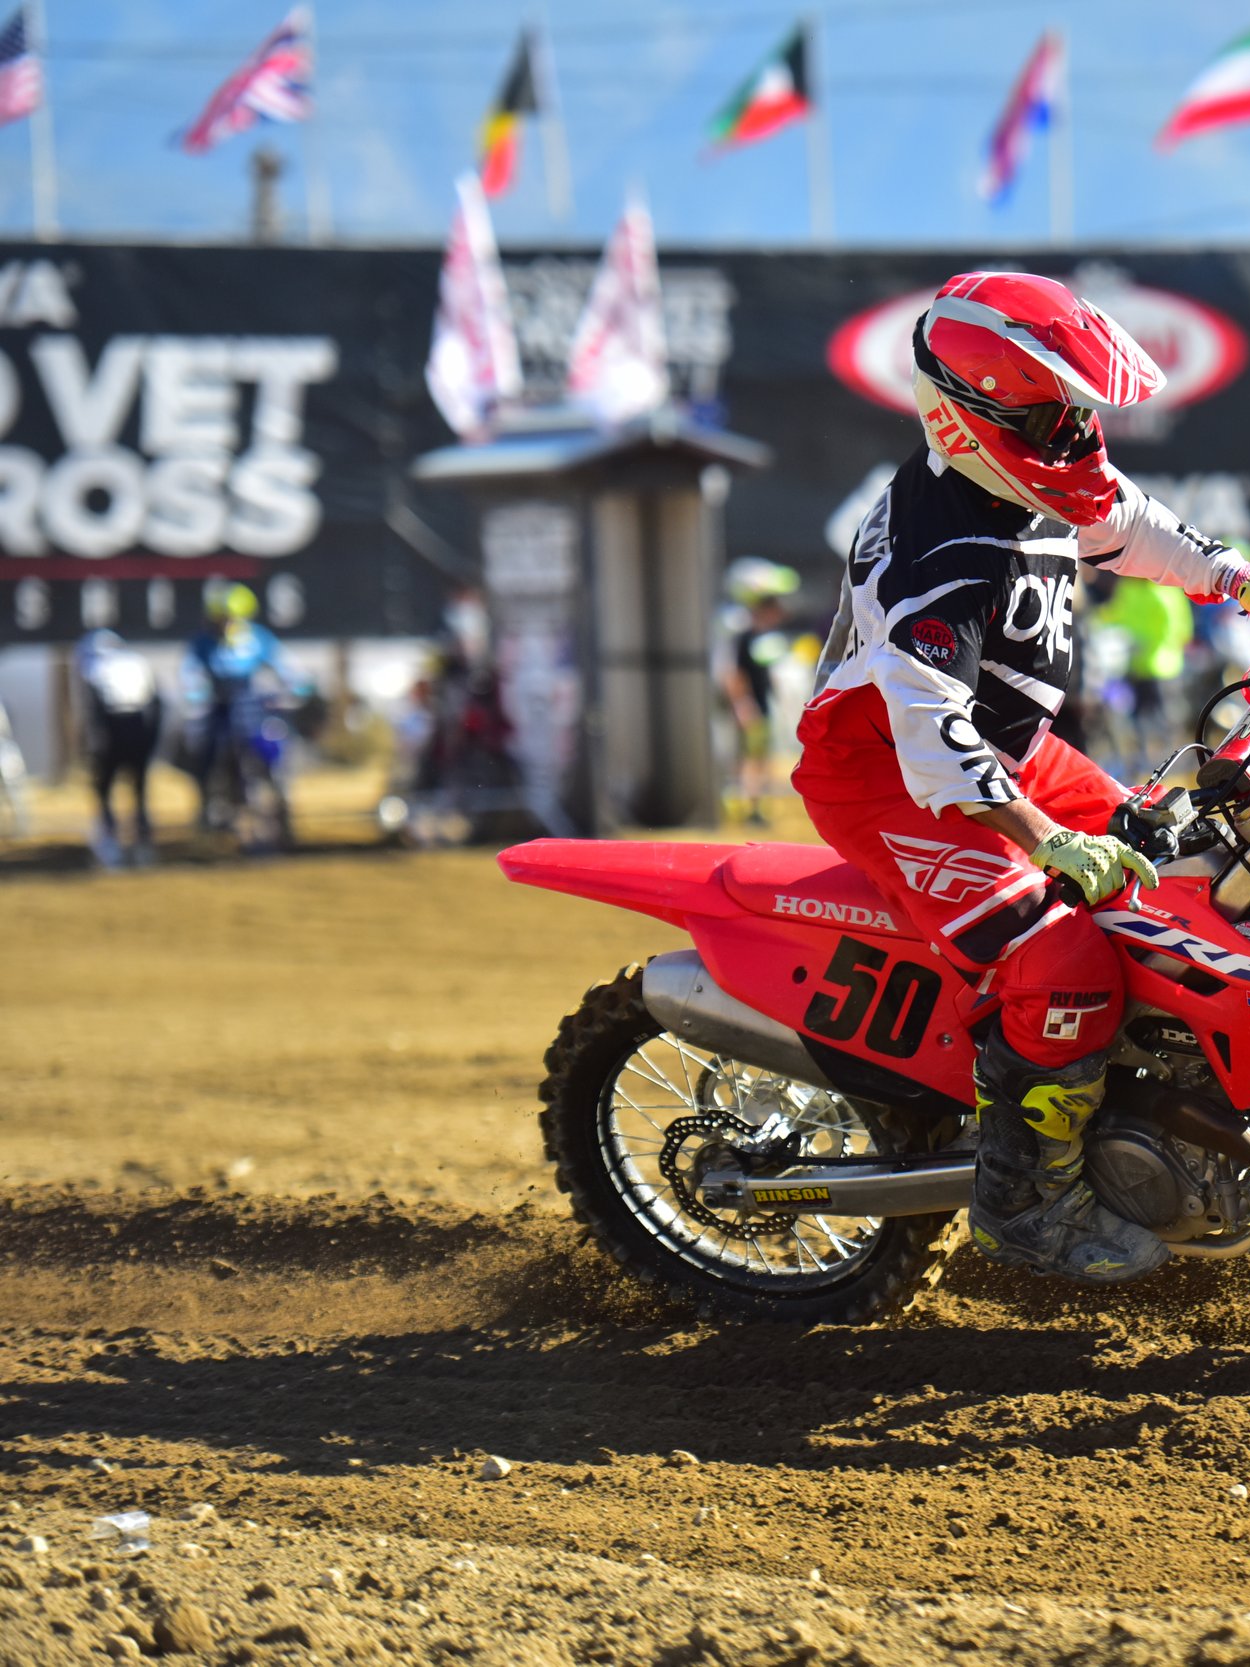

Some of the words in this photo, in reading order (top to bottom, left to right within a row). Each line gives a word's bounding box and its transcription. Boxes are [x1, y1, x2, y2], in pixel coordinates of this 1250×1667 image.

[30, 334, 338, 455] VET
[927, 400, 970, 457] FLY
[911, 637, 949, 660] WEAR
[914, 626, 951, 646] HARD
[773, 894, 898, 932] HONDA
[1125, 899, 1192, 930] 50R
[803, 935, 942, 1059] 50
[1048, 990, 1073, 1007] FLY
[753, 1187, 830, 1203] HINSON
